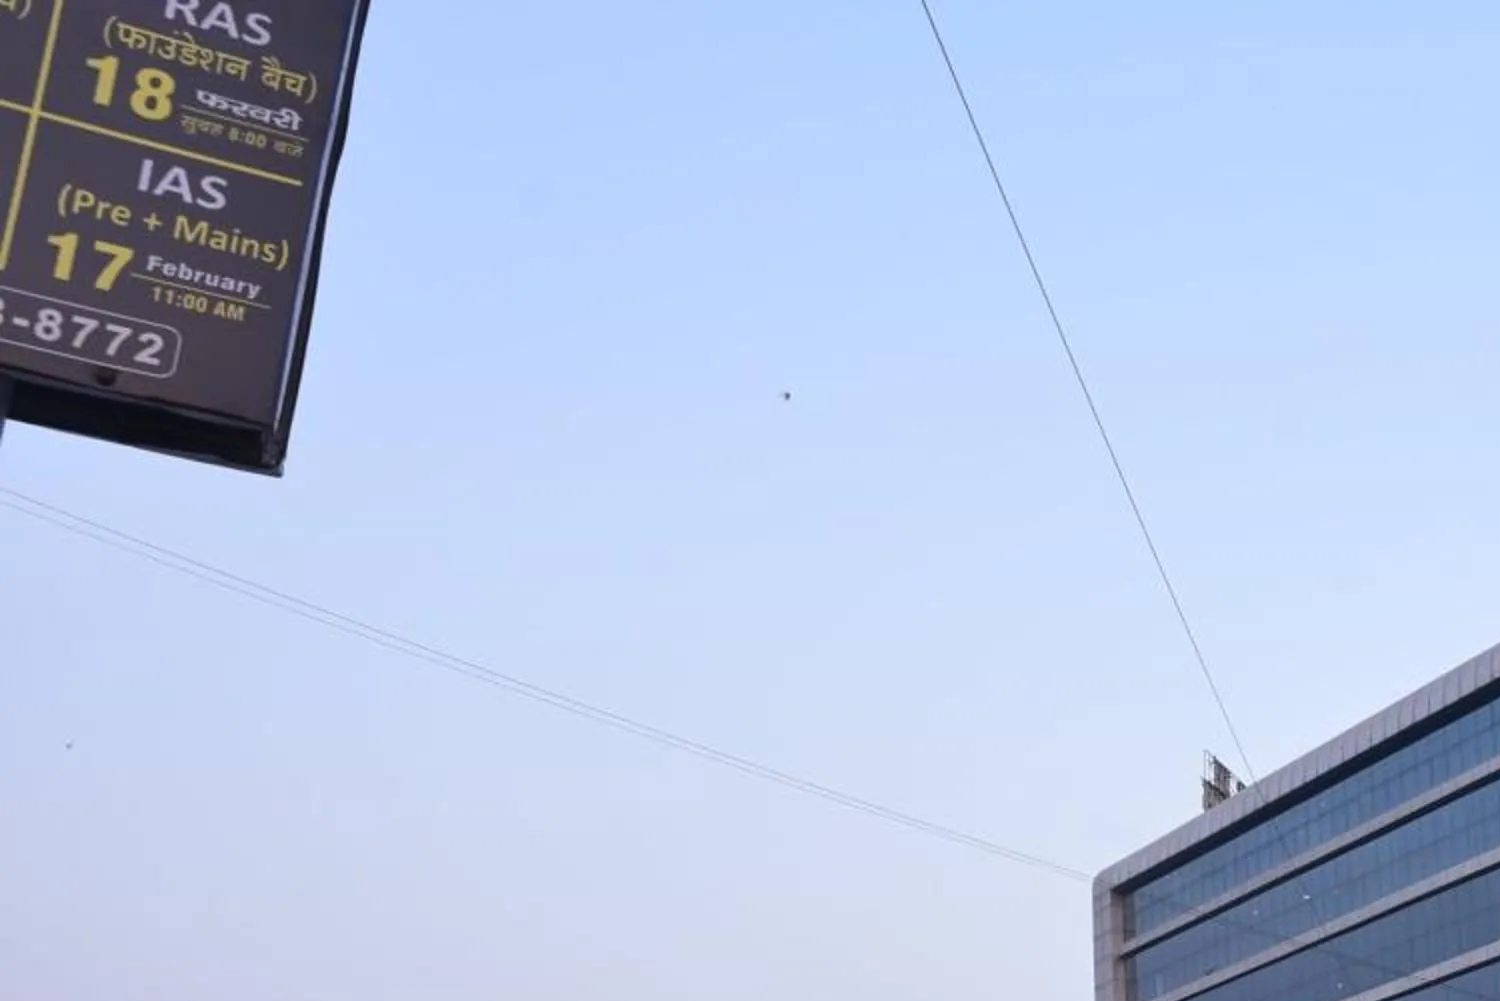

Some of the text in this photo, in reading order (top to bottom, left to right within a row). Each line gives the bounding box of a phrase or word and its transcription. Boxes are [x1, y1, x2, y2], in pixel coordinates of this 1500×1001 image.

[163, 0, 273, 46] RAS
[103, 15, 318, 104] (फाउंडेशन बैच)
[85, 55, 176, 121] 18
[196, 89, 303, 131] फरवरी
[137, 158, 229, 210] IAS
[57, 183, 290, 271] (Pre + Mains)
[48, 232, 135, 291] 17
[145, 255, 261, 299] February
[152, 287, 245, 321] 11:00 AM
